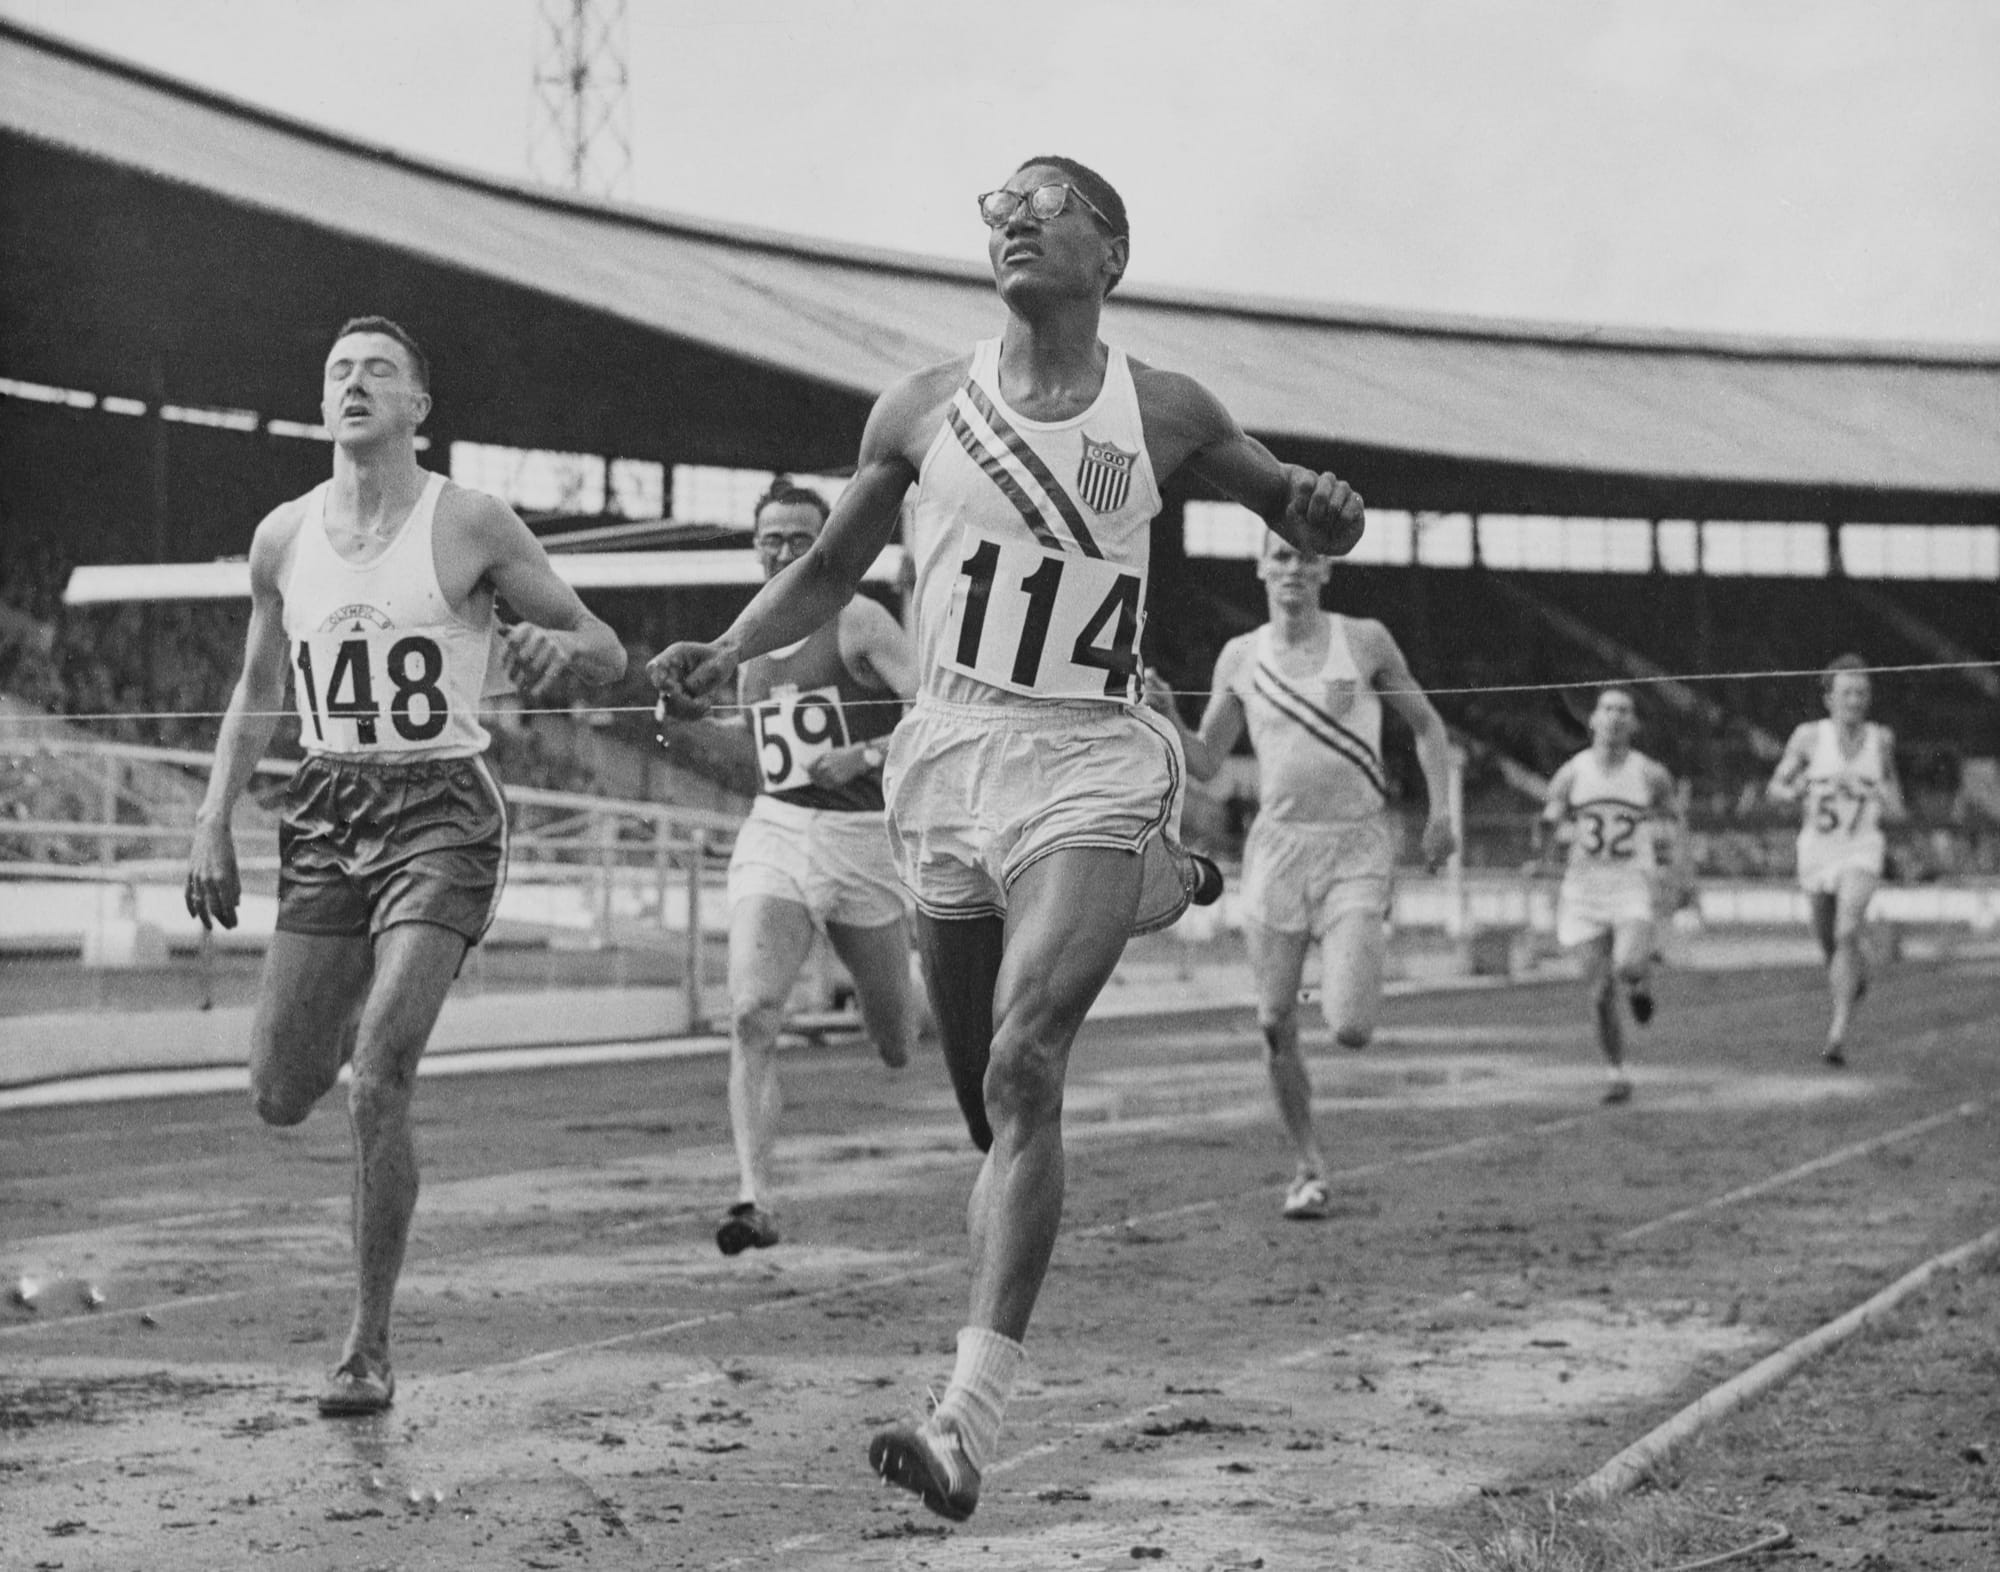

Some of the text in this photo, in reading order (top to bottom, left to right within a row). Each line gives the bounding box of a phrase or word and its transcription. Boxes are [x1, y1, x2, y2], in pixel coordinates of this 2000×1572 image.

[955, 539, 1142, 698] 114
[297, 636, 449, 744] 148
[759, 694, 846, 785] 59
[1581, 812, 1636, 858] 32
